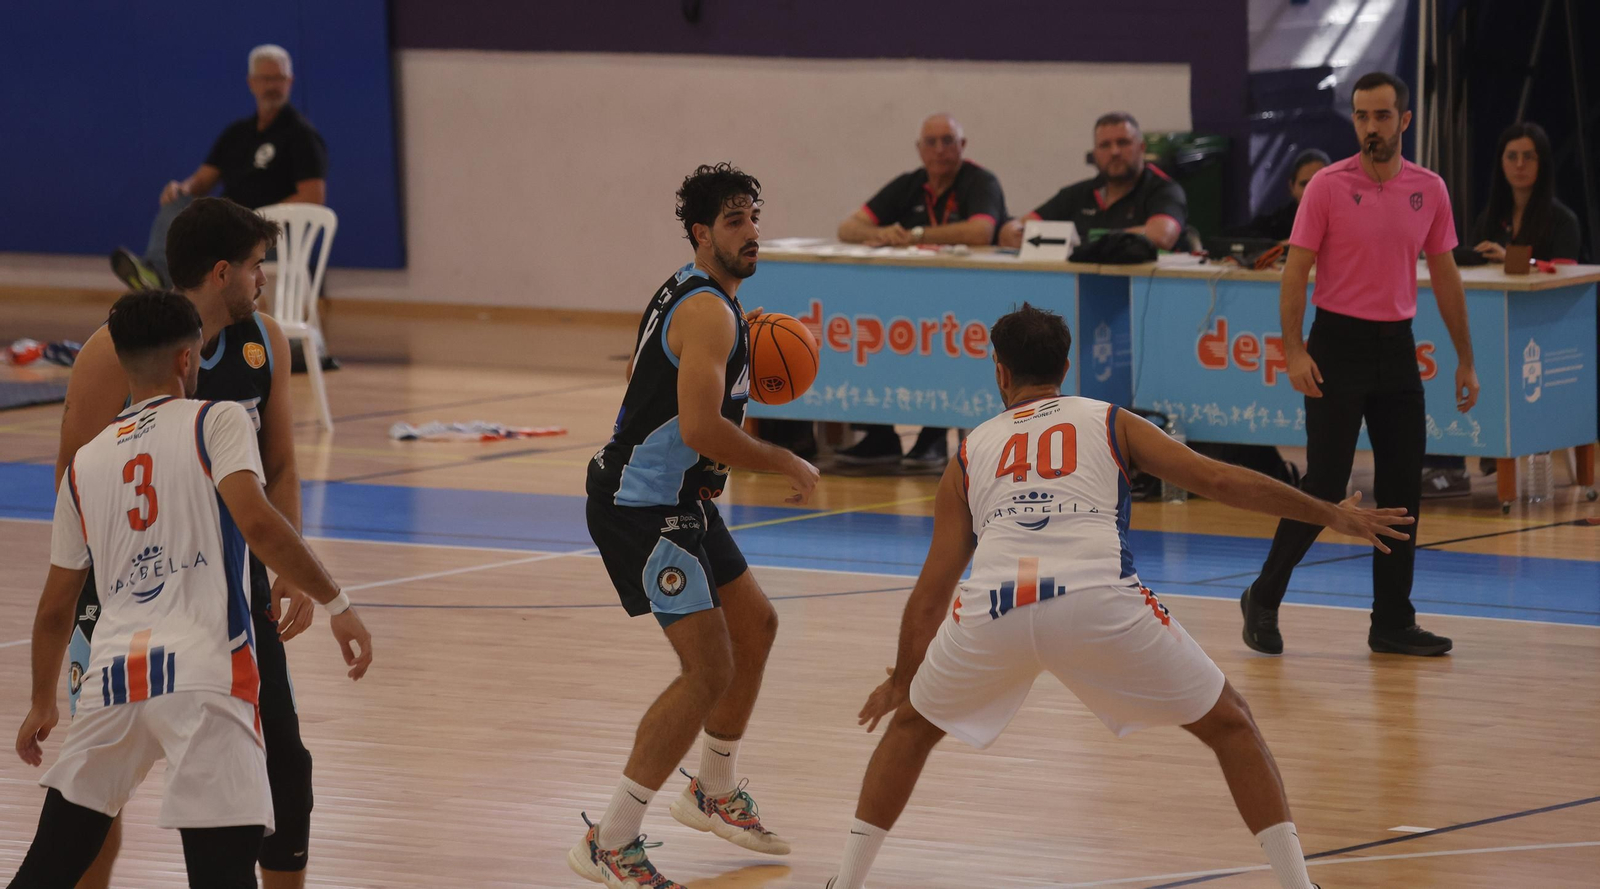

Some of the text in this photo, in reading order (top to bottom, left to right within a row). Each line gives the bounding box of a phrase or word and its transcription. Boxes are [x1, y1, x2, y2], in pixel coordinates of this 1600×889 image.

[797, 299, 990, 364] deporte
[995, 422, 1077, 483] 40
[122, 452, 158, 532] 3
